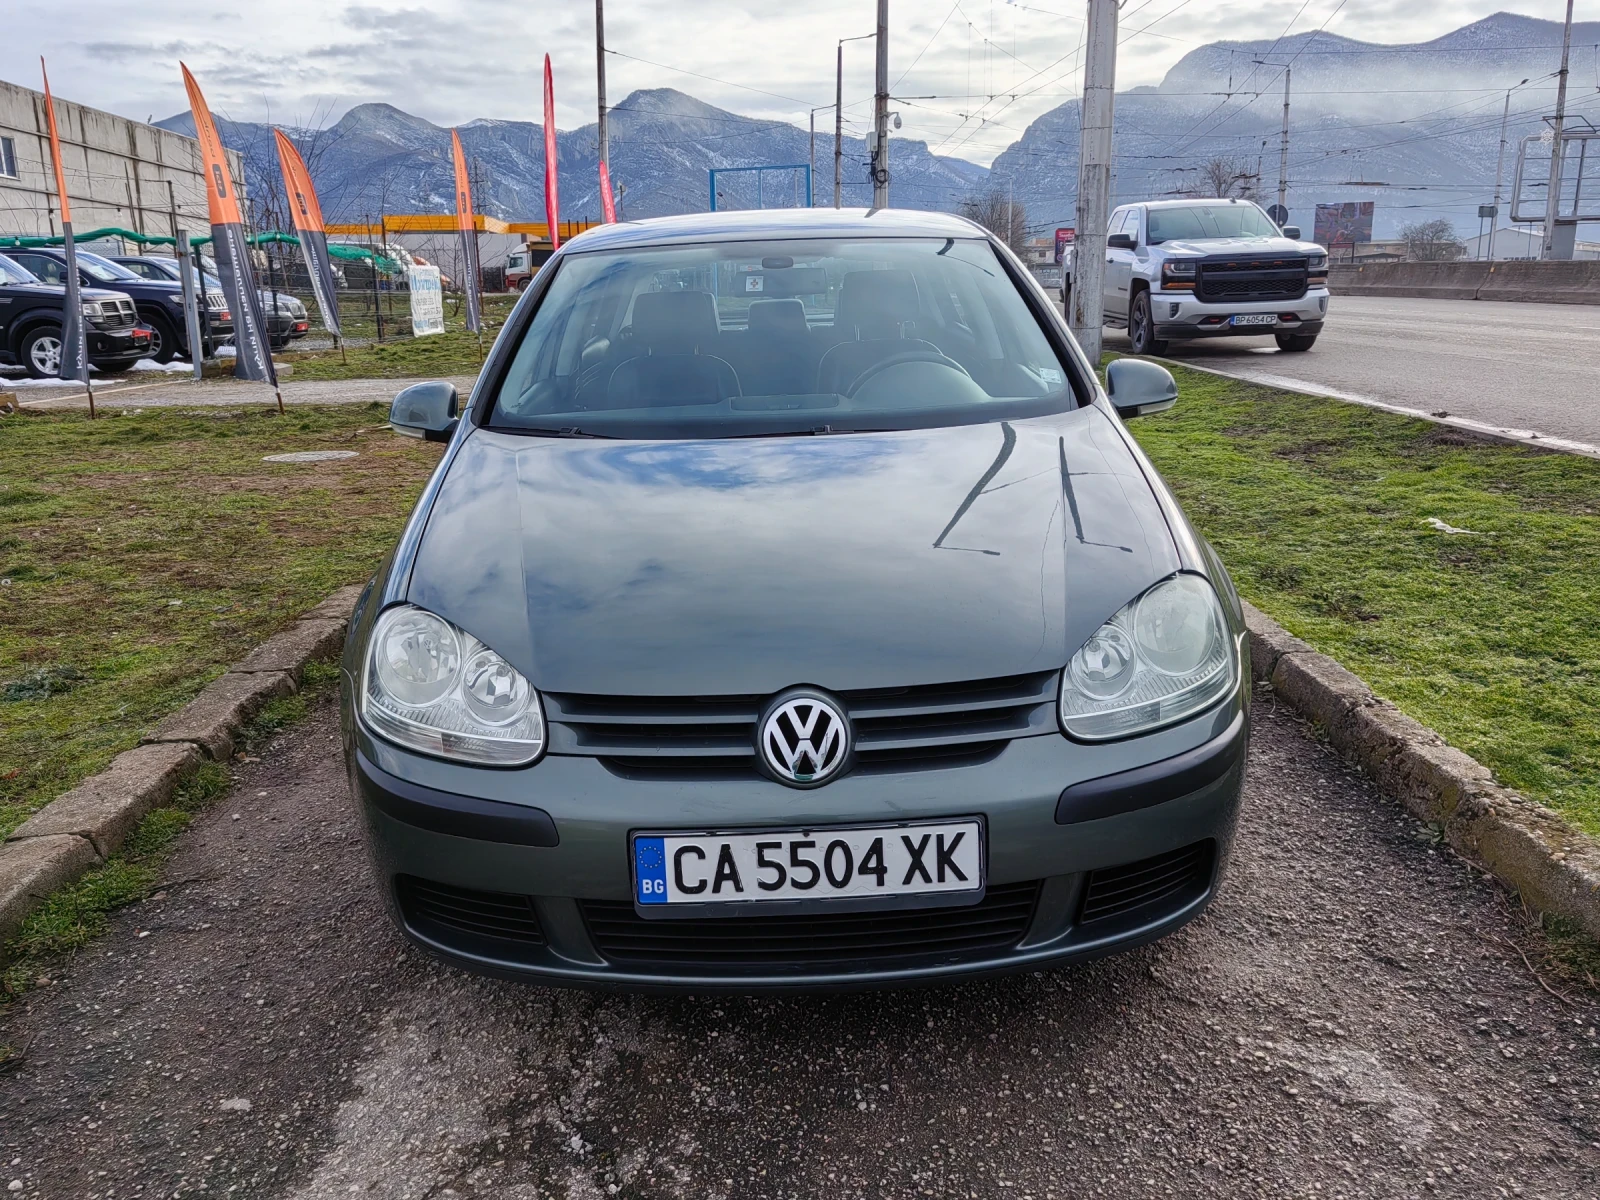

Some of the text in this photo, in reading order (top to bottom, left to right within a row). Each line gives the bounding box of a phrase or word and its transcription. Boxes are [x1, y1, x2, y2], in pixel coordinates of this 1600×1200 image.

[1246, 315, 1265, 324] 6054
[763, 698, 847, 781] VW
[673, 832, 969, 895] CA 5504 XK
[643, 880, 664, 894] BG
